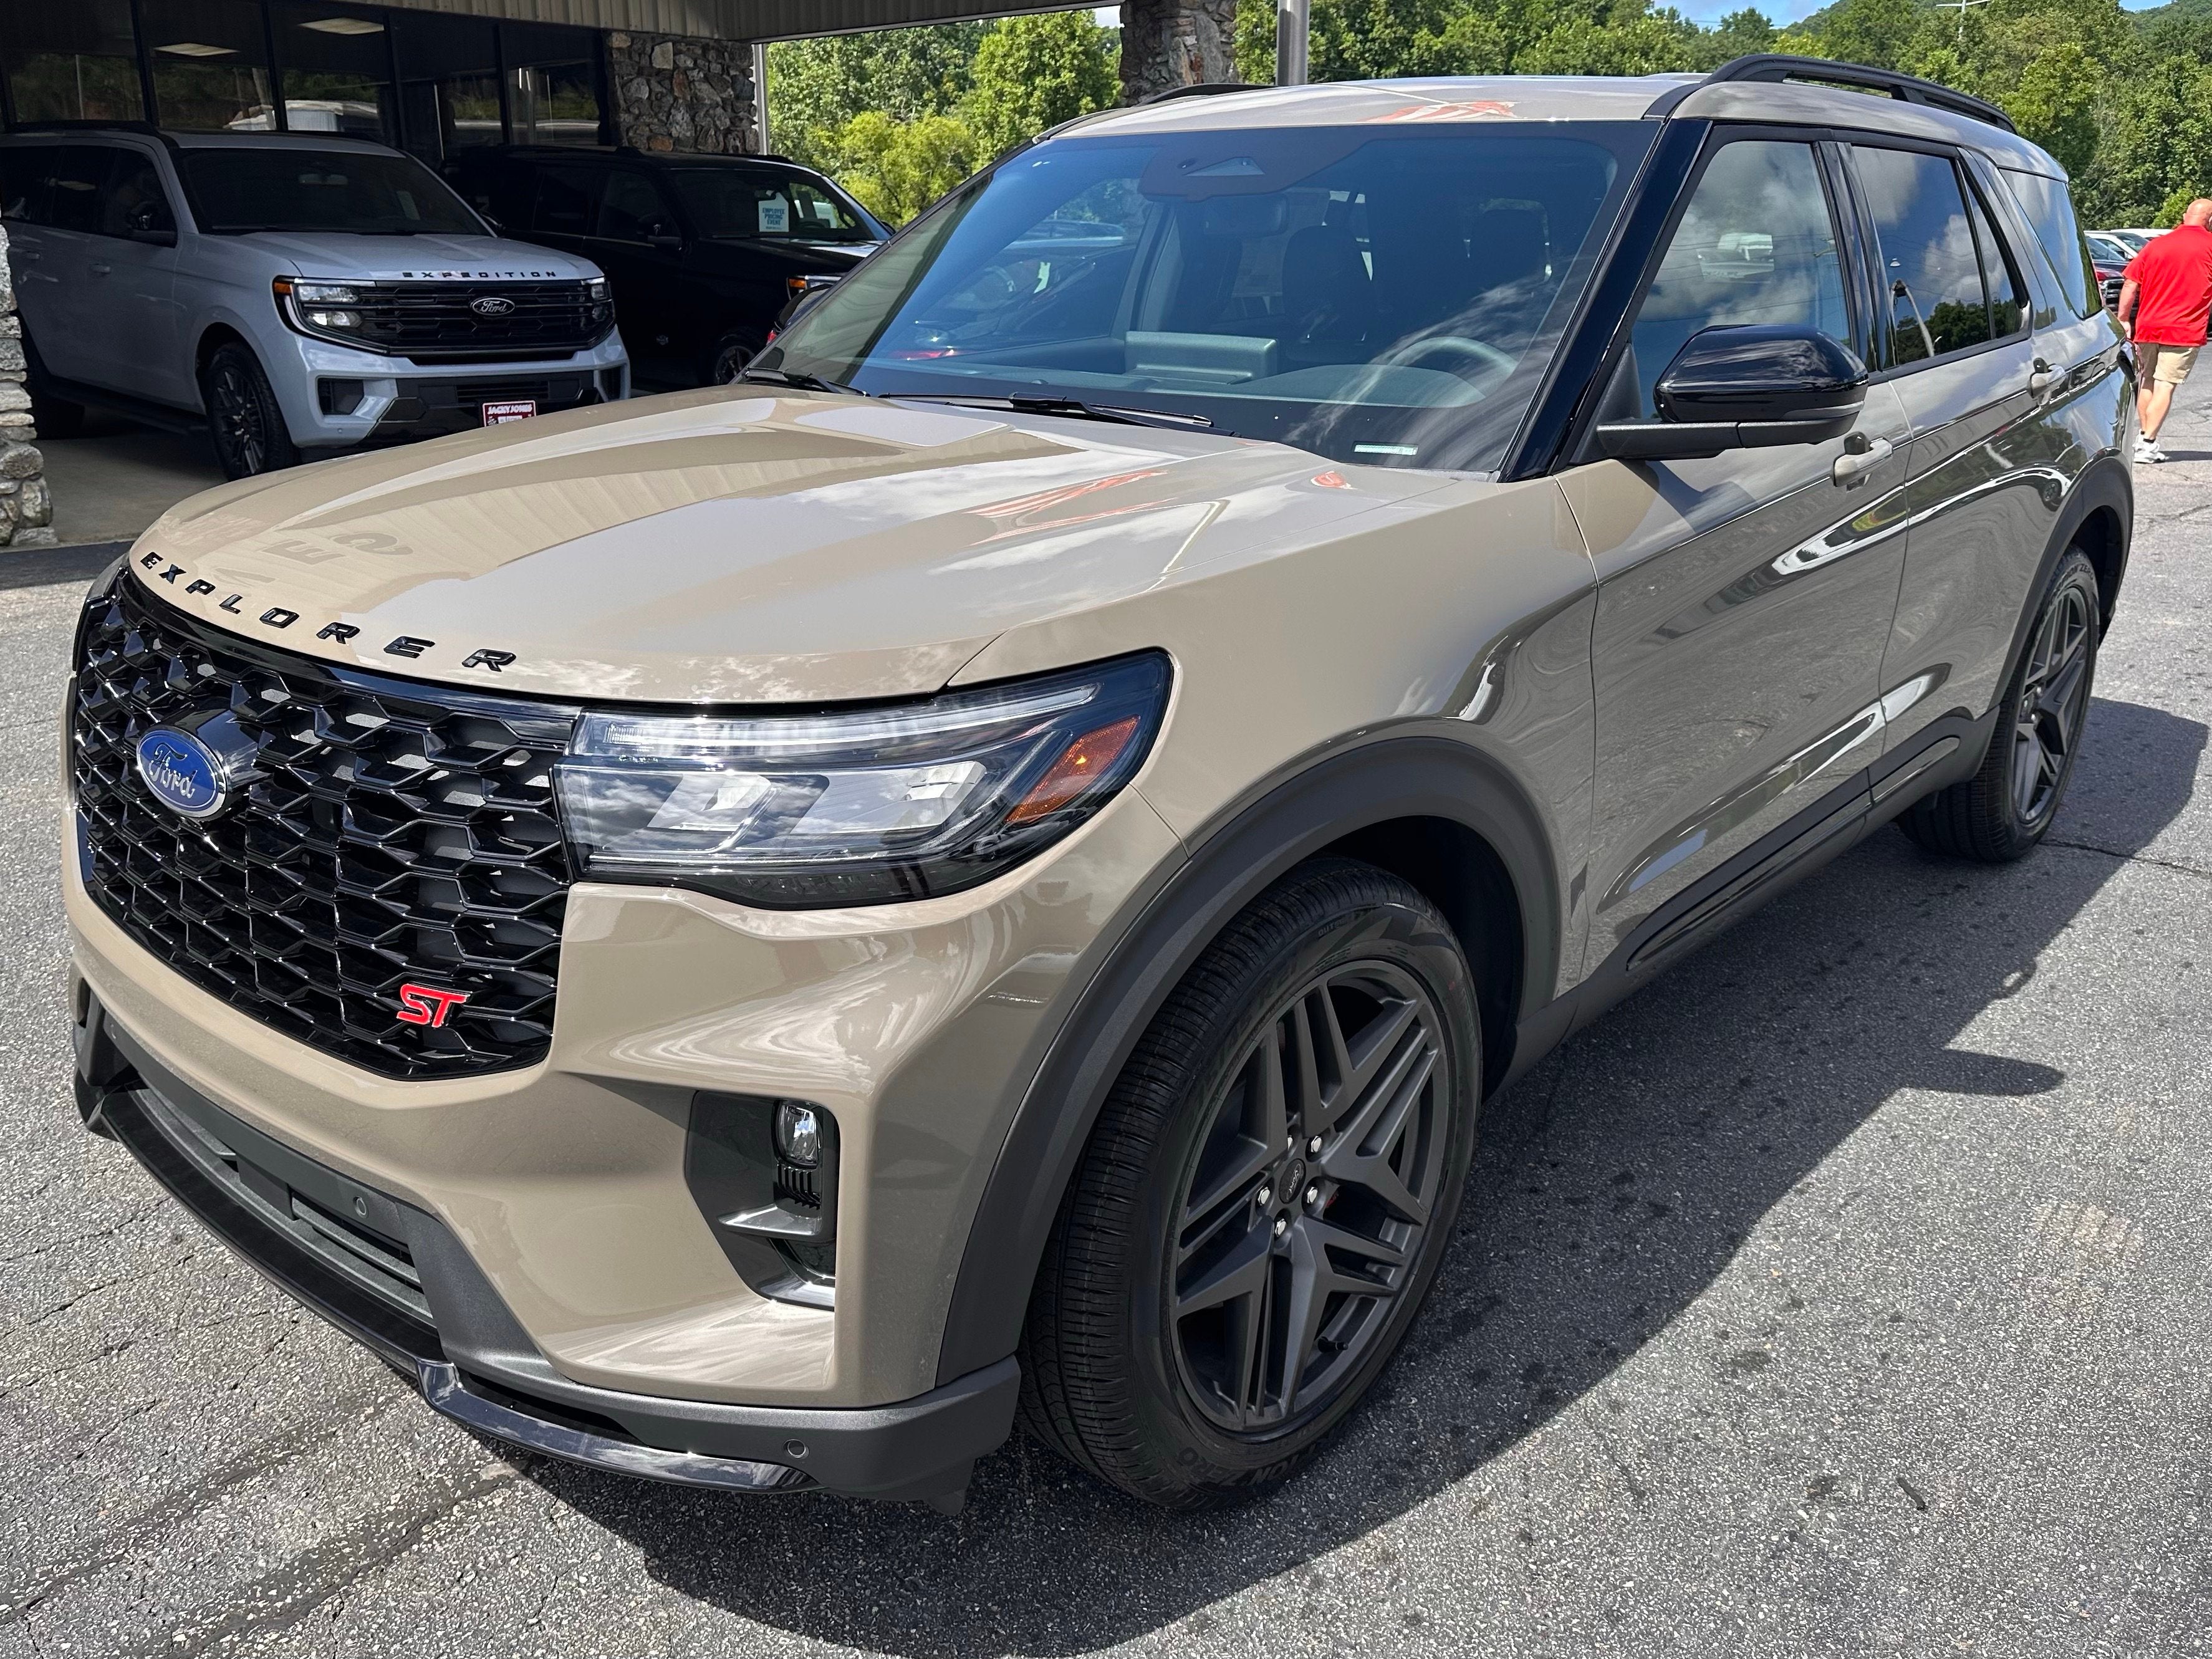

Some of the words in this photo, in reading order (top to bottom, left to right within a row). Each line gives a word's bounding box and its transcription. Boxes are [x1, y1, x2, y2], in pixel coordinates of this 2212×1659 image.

[480, 300, 508, 313] Ford
[141, 551, 517, 673] EXPLORER
[148, 742, 198, 799] Ford
[396, 983, 471, 1028] ST
